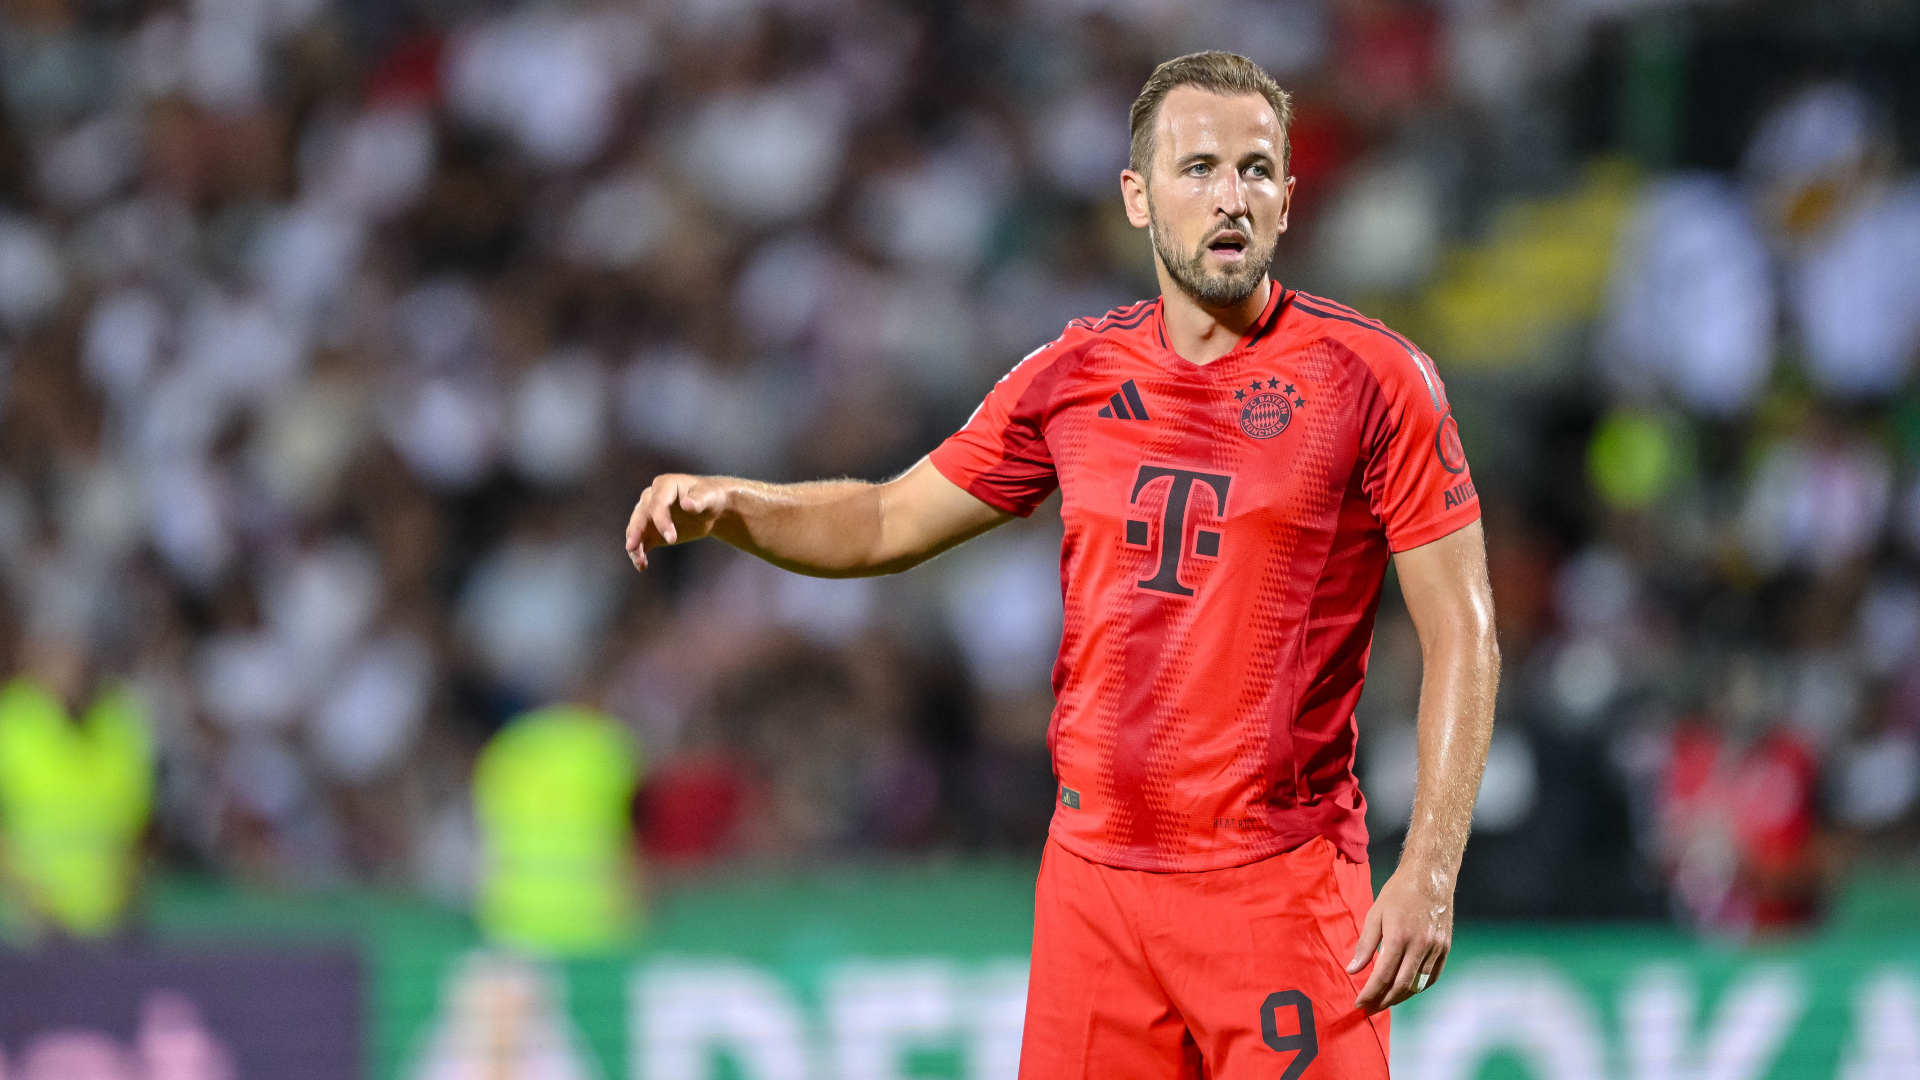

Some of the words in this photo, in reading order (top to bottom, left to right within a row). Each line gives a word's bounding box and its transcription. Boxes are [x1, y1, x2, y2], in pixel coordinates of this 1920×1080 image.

[1246, 400, 1257, 411] FC
[1258, 395, 1288, 415] BAYERN
[1260, 989, 1319, 1080] 9
